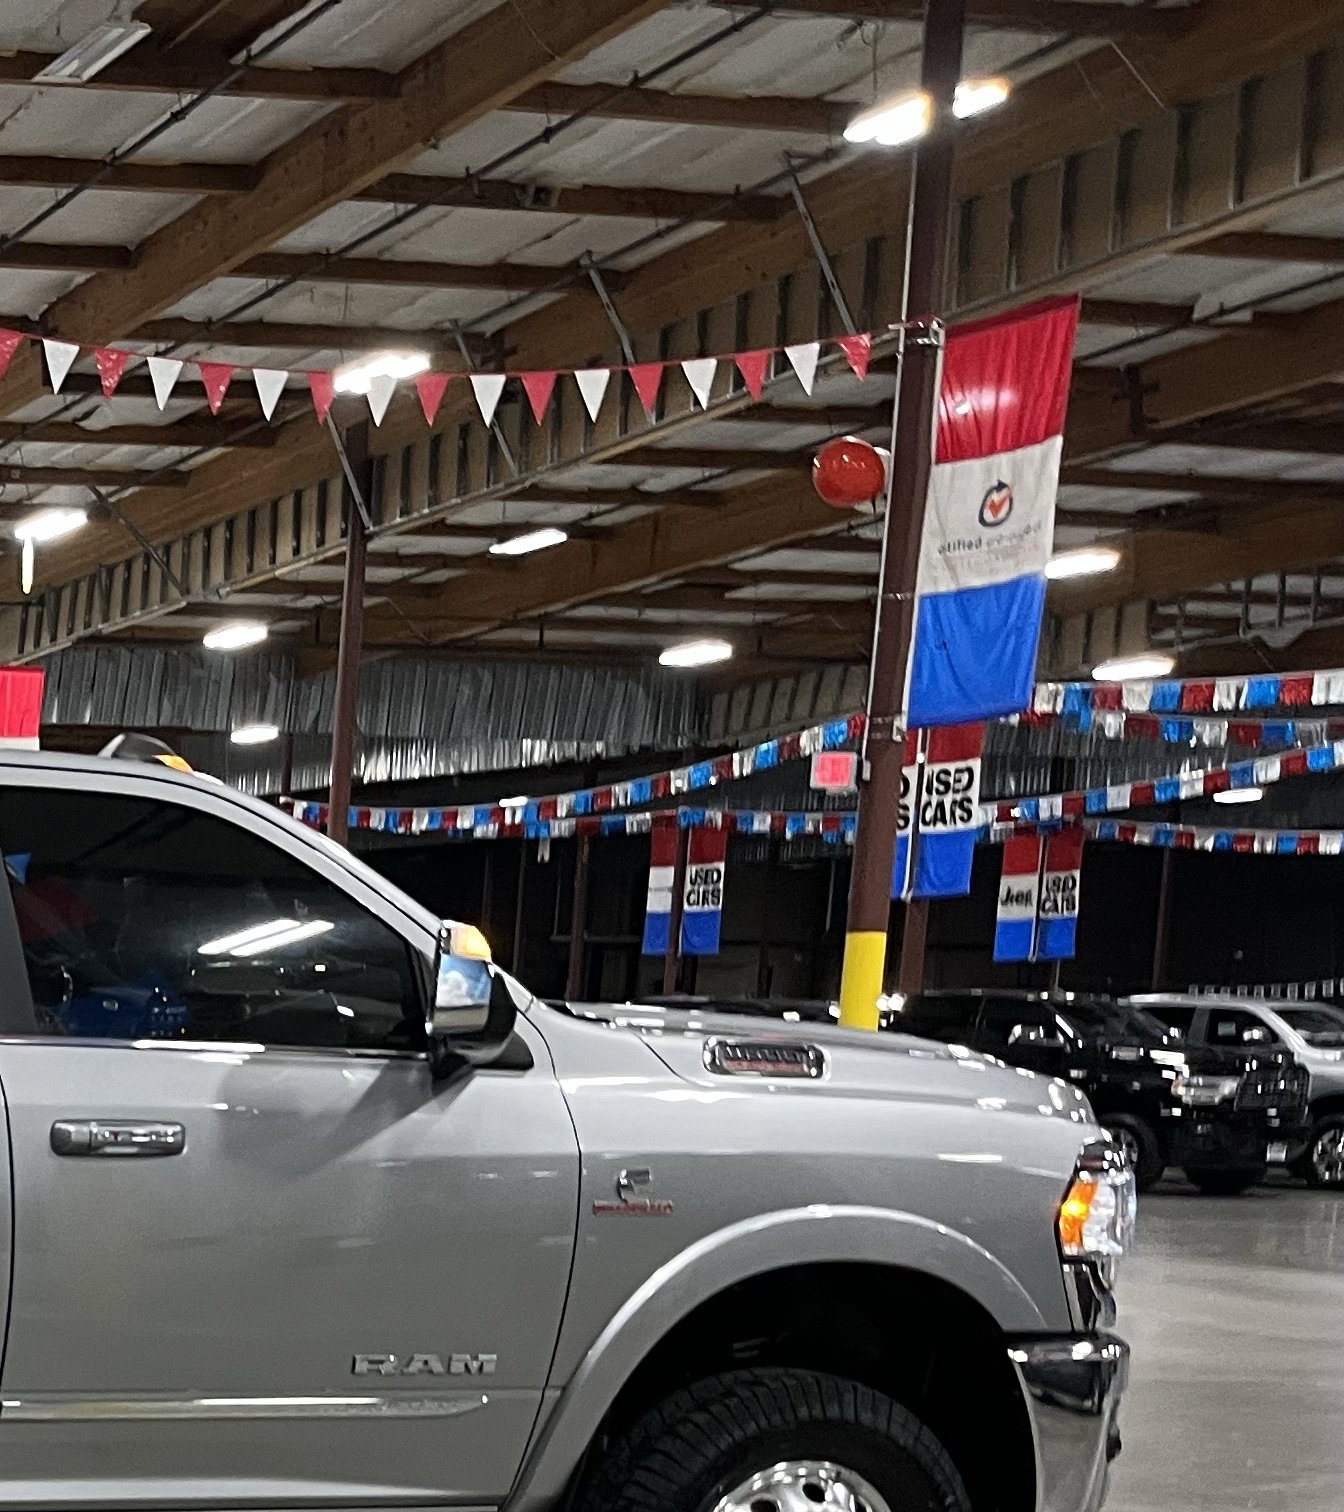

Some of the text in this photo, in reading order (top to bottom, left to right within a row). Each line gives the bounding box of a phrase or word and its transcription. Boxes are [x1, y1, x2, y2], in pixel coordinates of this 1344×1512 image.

[925, 766, 975, 796] USED
[690, 868, 722, 886] USED
[351, 1353, 498, 1376] RAM
